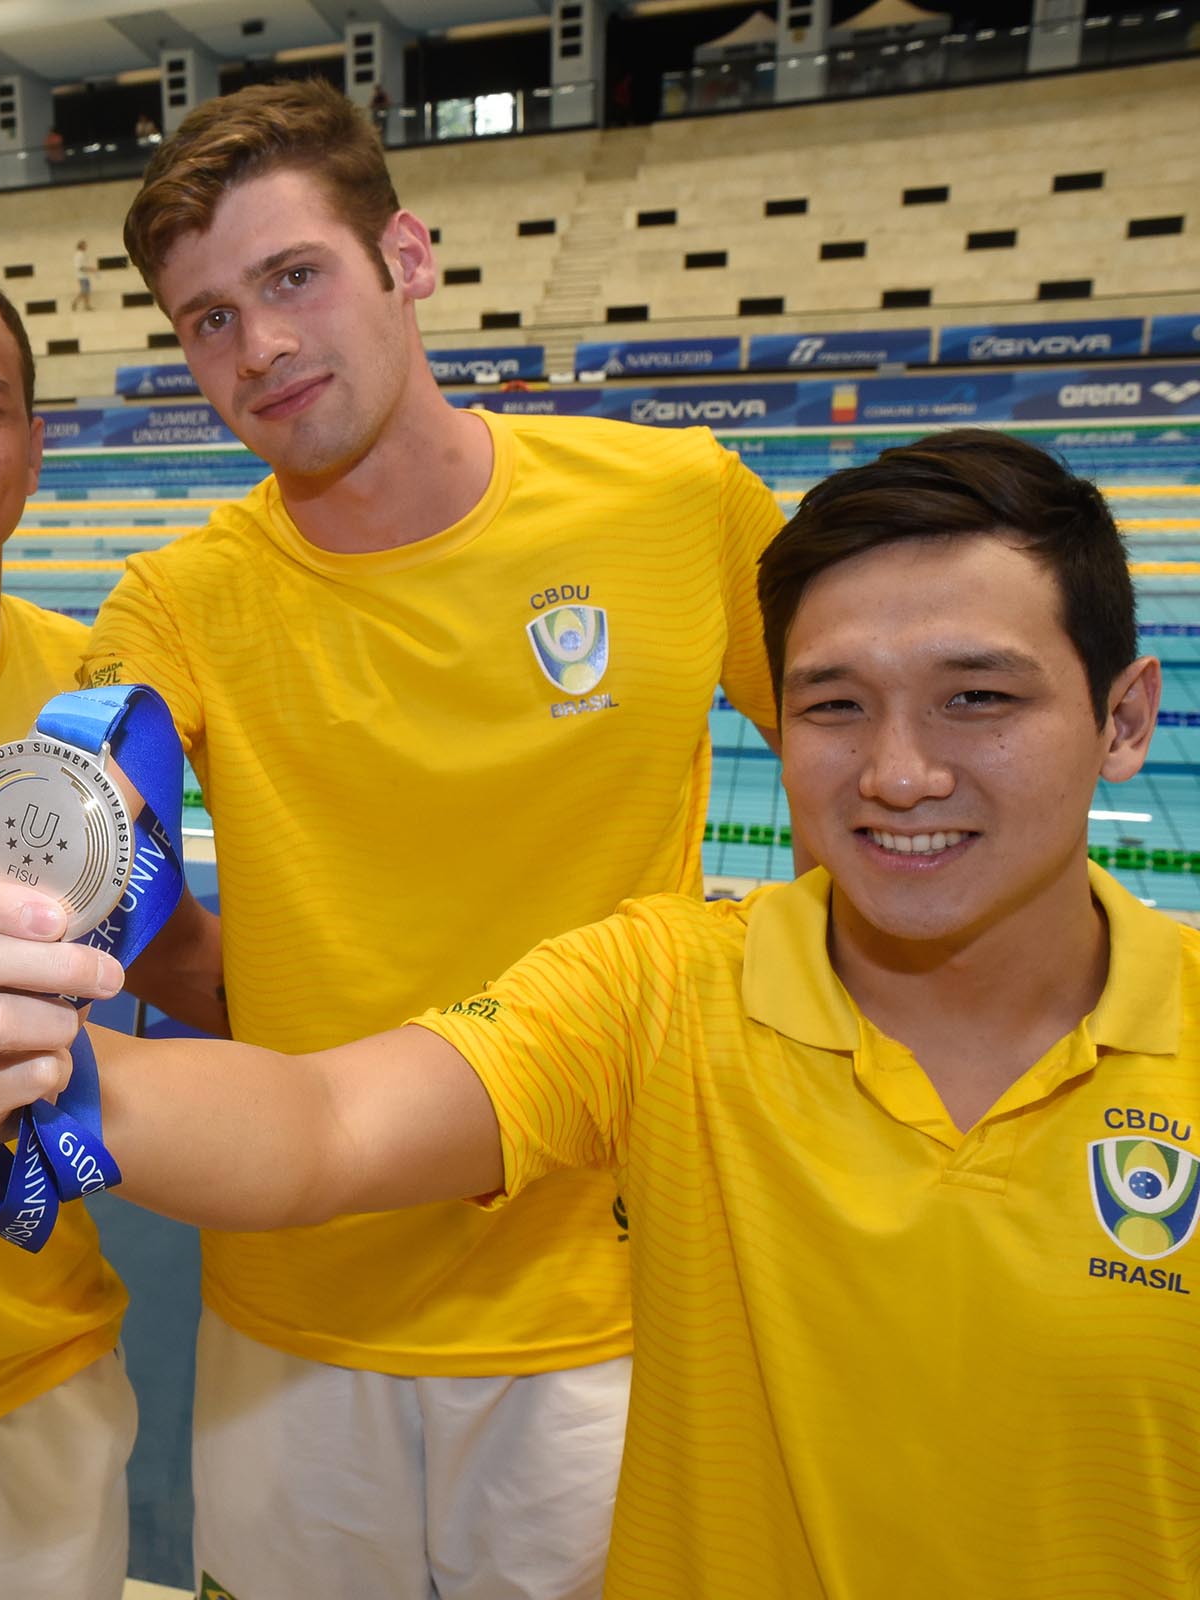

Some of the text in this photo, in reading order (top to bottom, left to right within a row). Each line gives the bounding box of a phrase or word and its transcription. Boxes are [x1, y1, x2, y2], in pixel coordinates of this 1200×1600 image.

[995, 334, 1112, 356] GIVOVA
[1058, 383, 1142, 408] arena
[655, 399, 768, 421] GIVOVA
[530, 584, 590, 610] CBDU
[551, 693, 619, 719] BRASIL
[33, 742, 90, 771] SUMMER
[93, 772, 129, 888] UNIVERSIADE
[6, 864, 40, 887] FISU
[1103, 1107, 1191, 1141] CBDU
[1088, 1257, 1191, 1295] BRASIL
